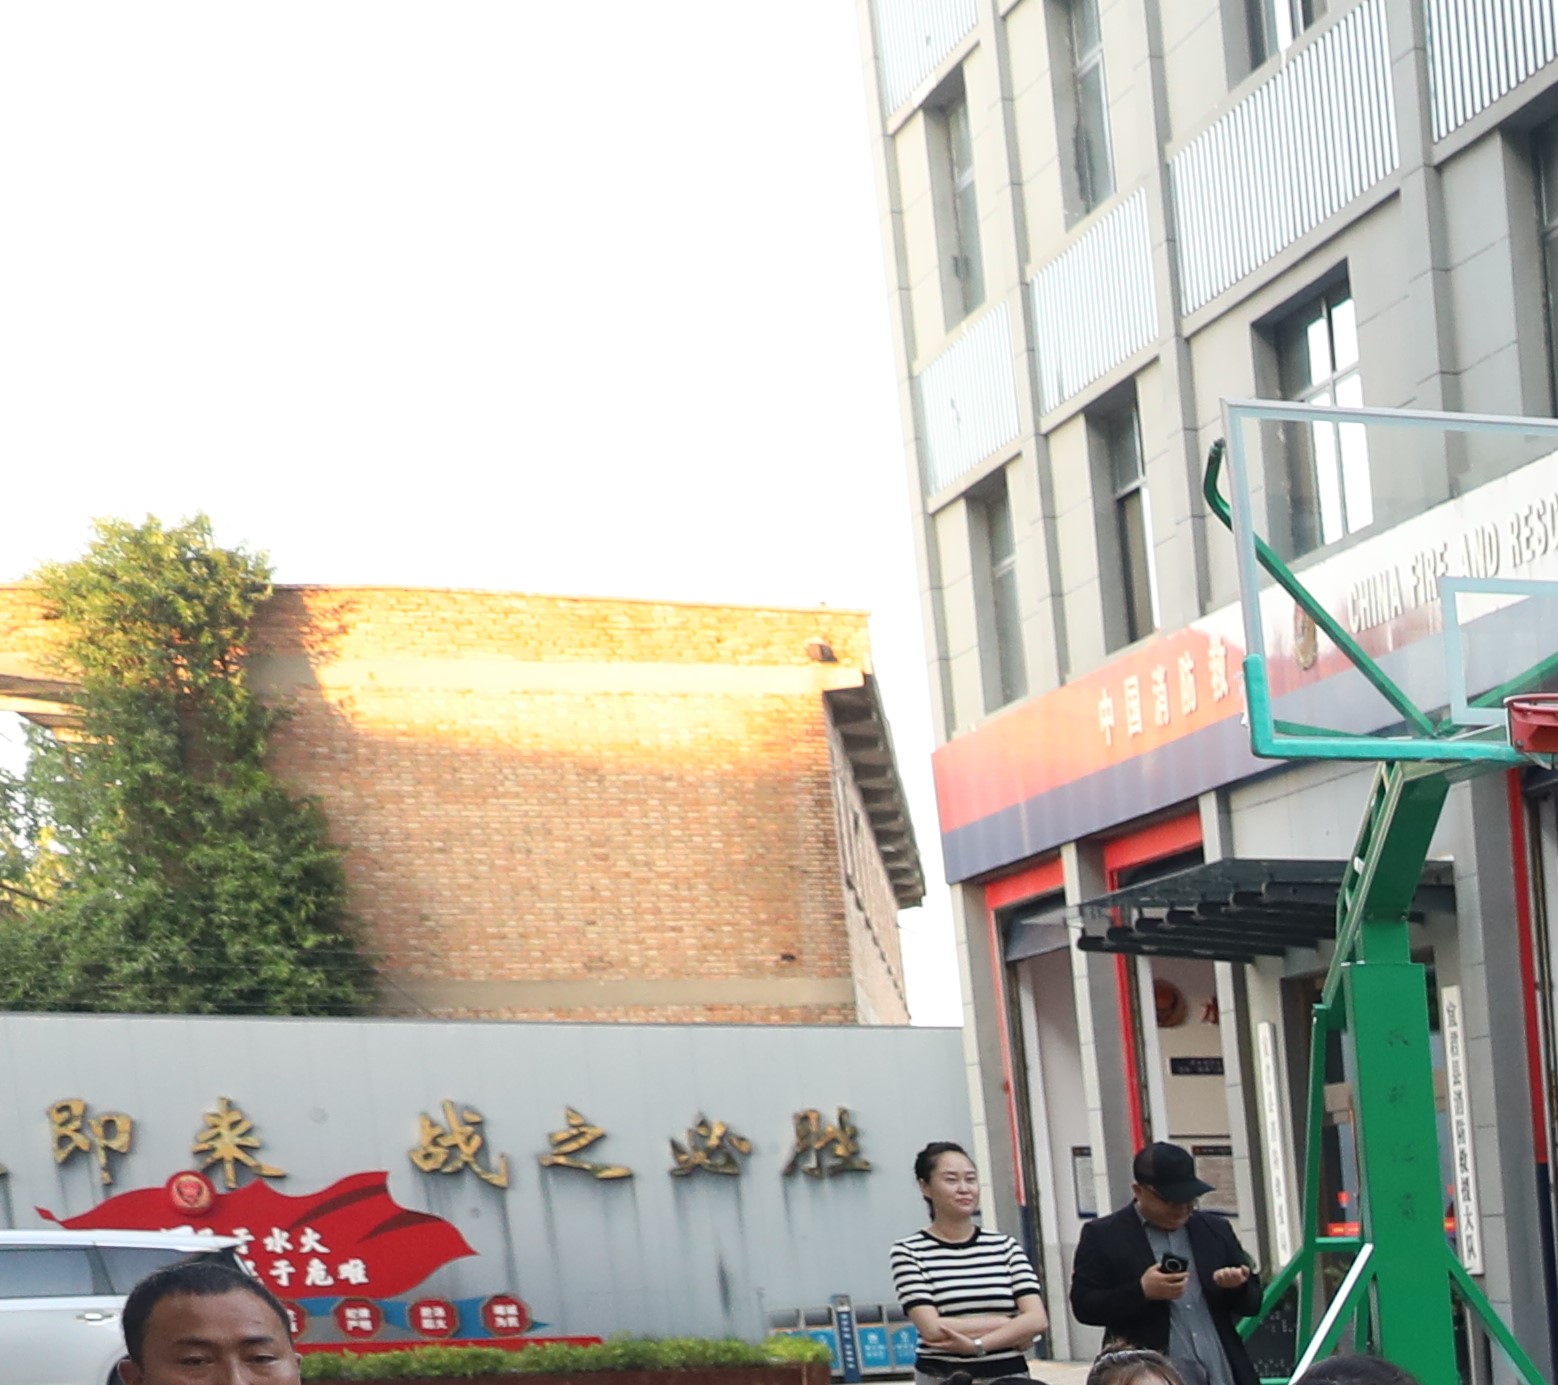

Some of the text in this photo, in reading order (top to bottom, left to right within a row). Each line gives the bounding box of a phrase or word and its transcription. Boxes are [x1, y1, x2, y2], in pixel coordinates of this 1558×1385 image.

[1350, 565, 1405, 634] CHINA
[1460, 521, 1501, 580] AND
[0, 1096, 872, 1190] 即来 战之必胜
